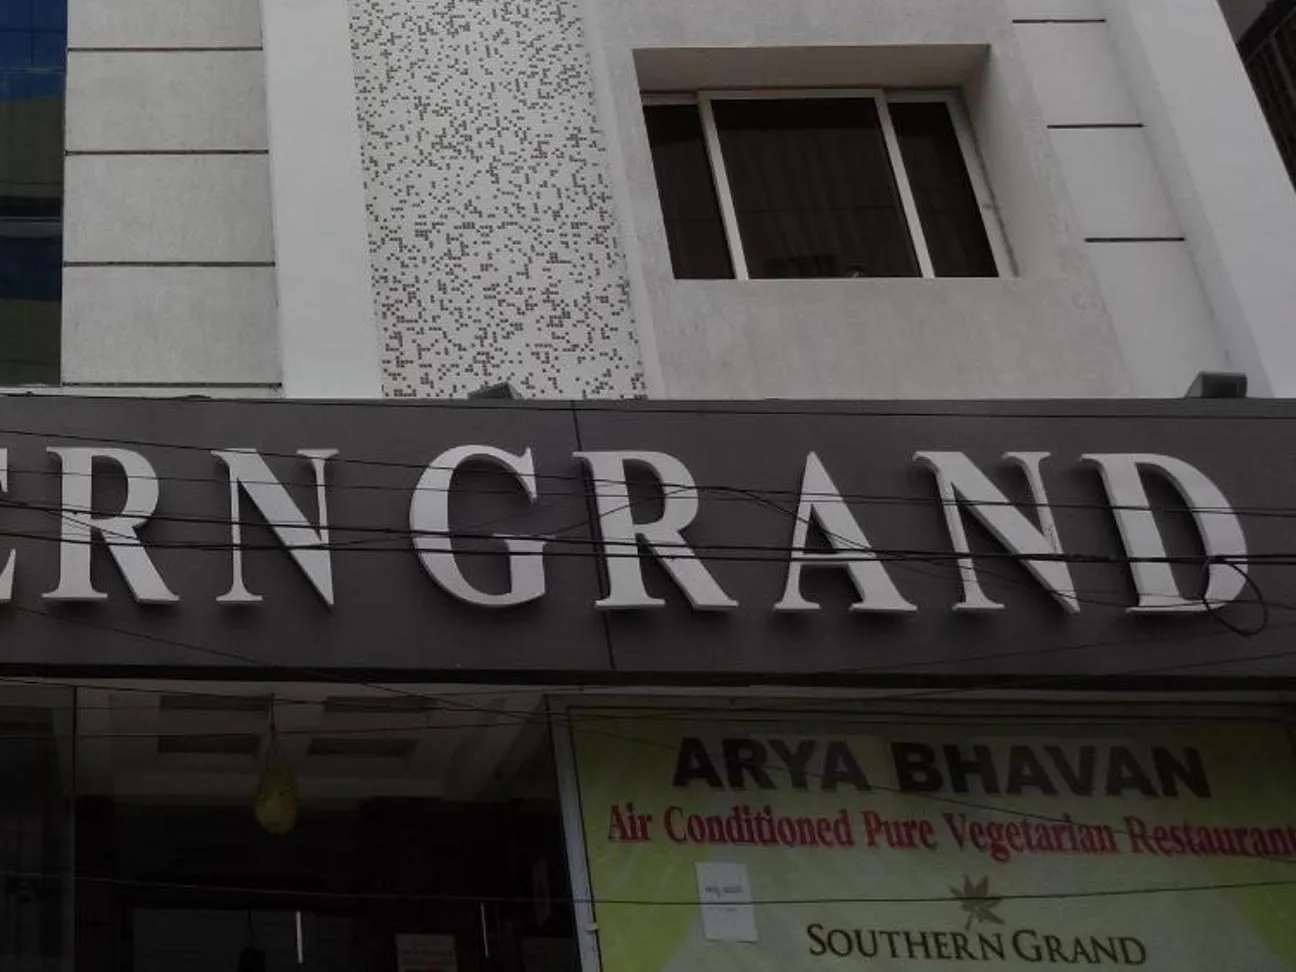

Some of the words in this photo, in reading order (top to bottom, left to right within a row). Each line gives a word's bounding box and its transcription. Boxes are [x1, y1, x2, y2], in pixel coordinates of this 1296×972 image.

[408, 443, 1250, 614] GRAND
[671, 736, 872, 792] ARYA
[888, 740, 1212, 799] BHAVAN
[607, 803, 653, 843] Air
[663, 804, 855, 850] Conditioned
[862, 809, 937, 851] Pure
[942, 812, 1118, 862] Vegetarian
[806, 923, 1005, 962] SOUTHERN
[1010, 928, 1148, 966] GRAND
